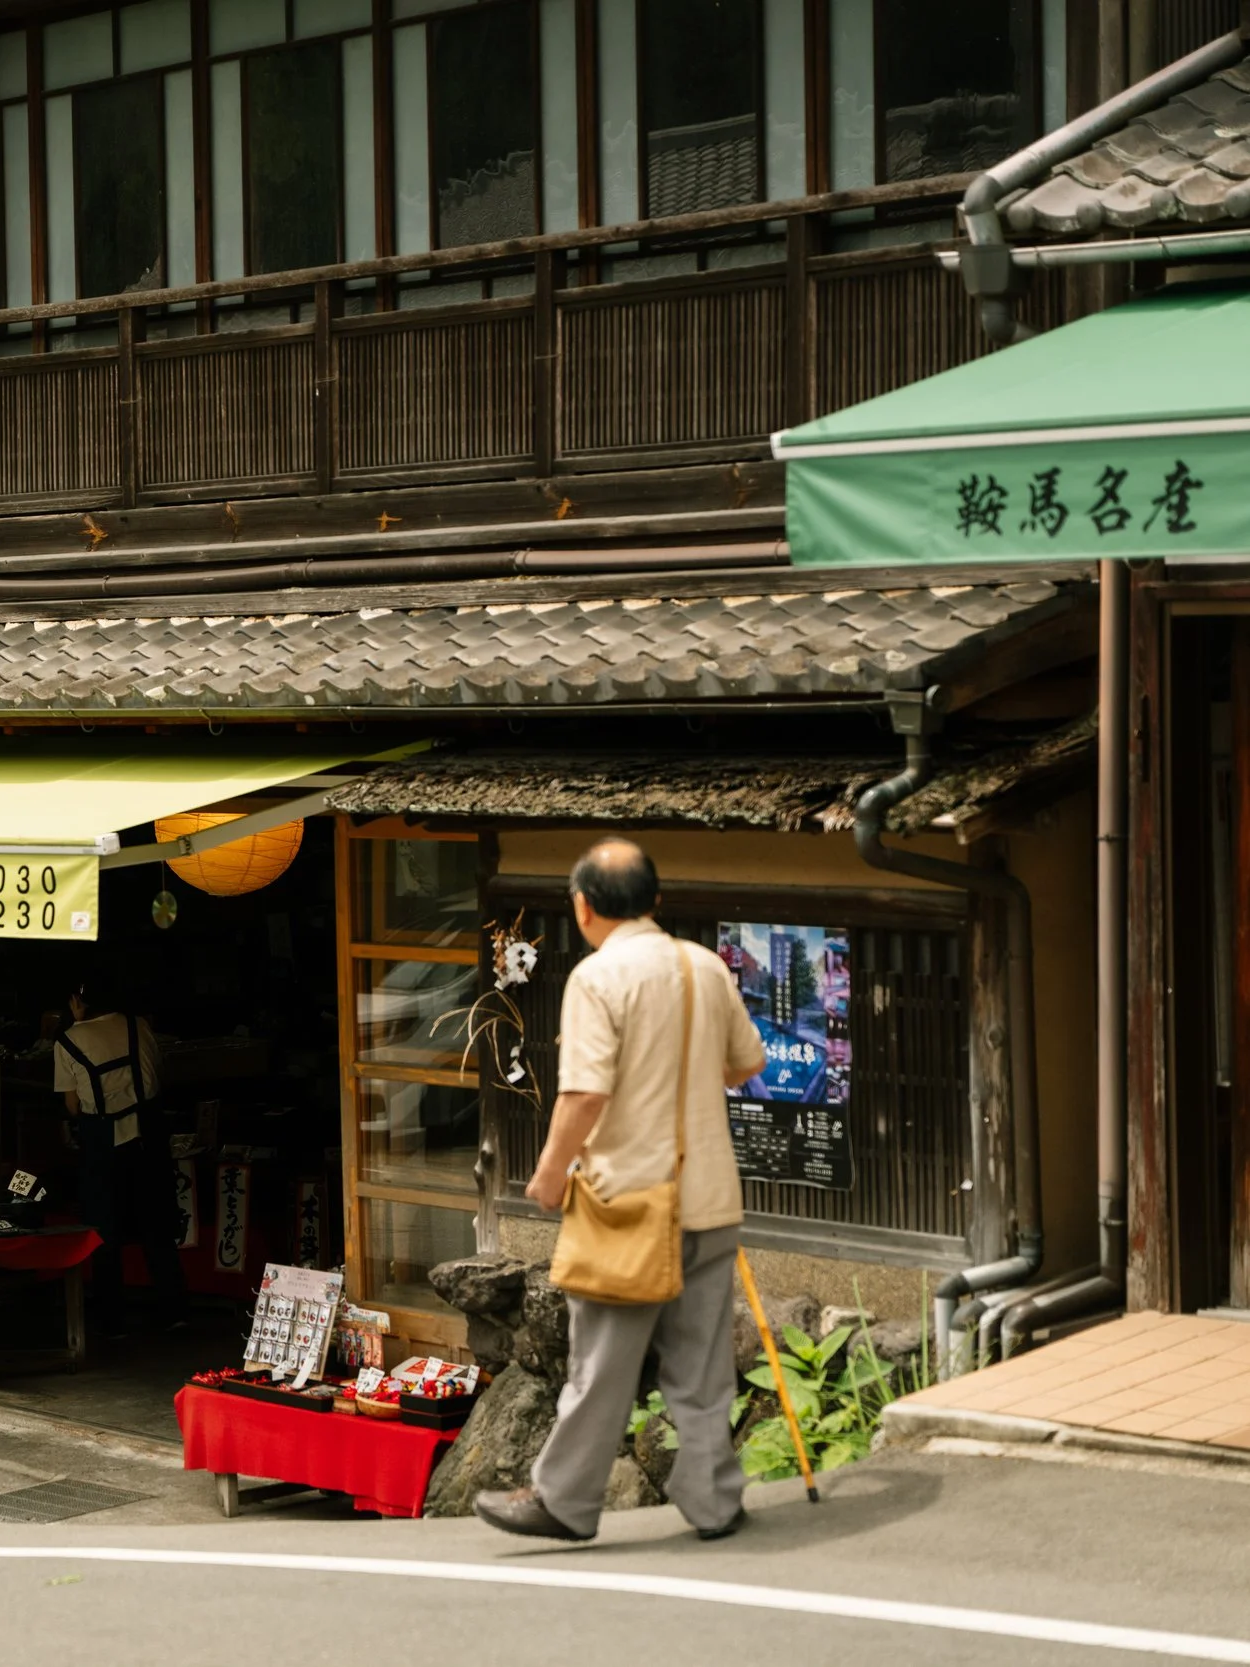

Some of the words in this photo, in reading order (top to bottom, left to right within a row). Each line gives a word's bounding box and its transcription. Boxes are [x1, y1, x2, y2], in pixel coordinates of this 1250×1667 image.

[955, 458, 1204, 538] 鞍馬名産
[219, 1168, 245, 1268] 葉とうがらし
